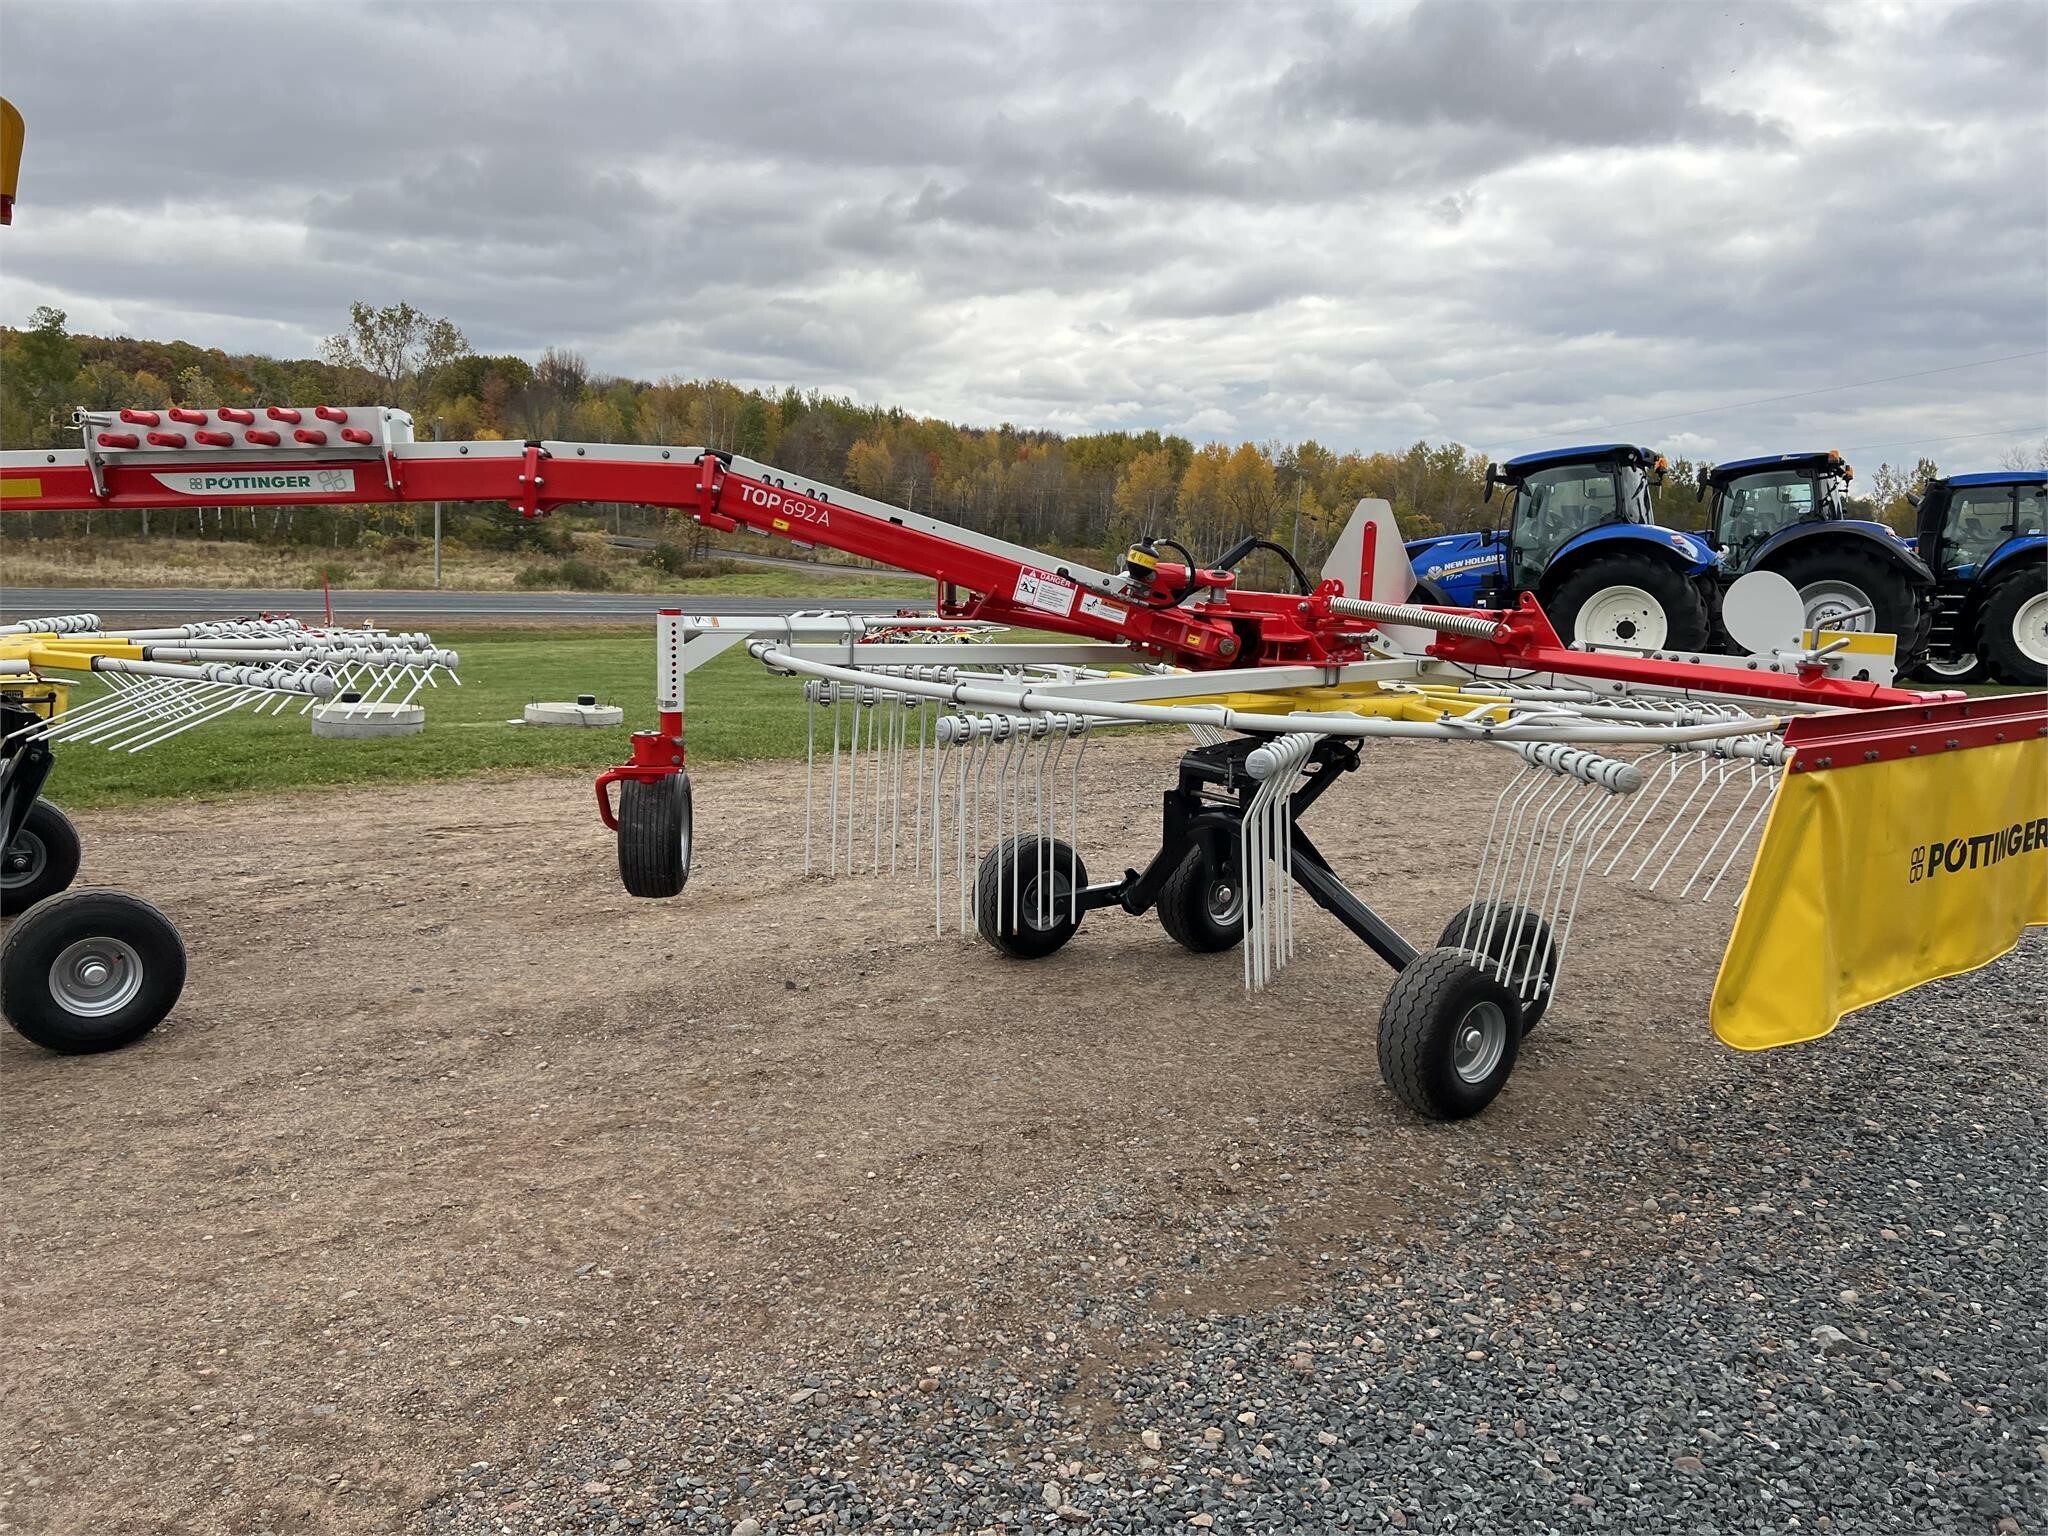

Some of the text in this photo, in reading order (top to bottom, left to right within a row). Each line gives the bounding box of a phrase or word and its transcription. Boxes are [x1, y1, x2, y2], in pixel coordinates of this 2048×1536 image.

[741, 484, 781, 509] TOP
[1444, 554, 1505, 570] NEW HOLLAND
[1040, 572, 1071, 587] DANGER
